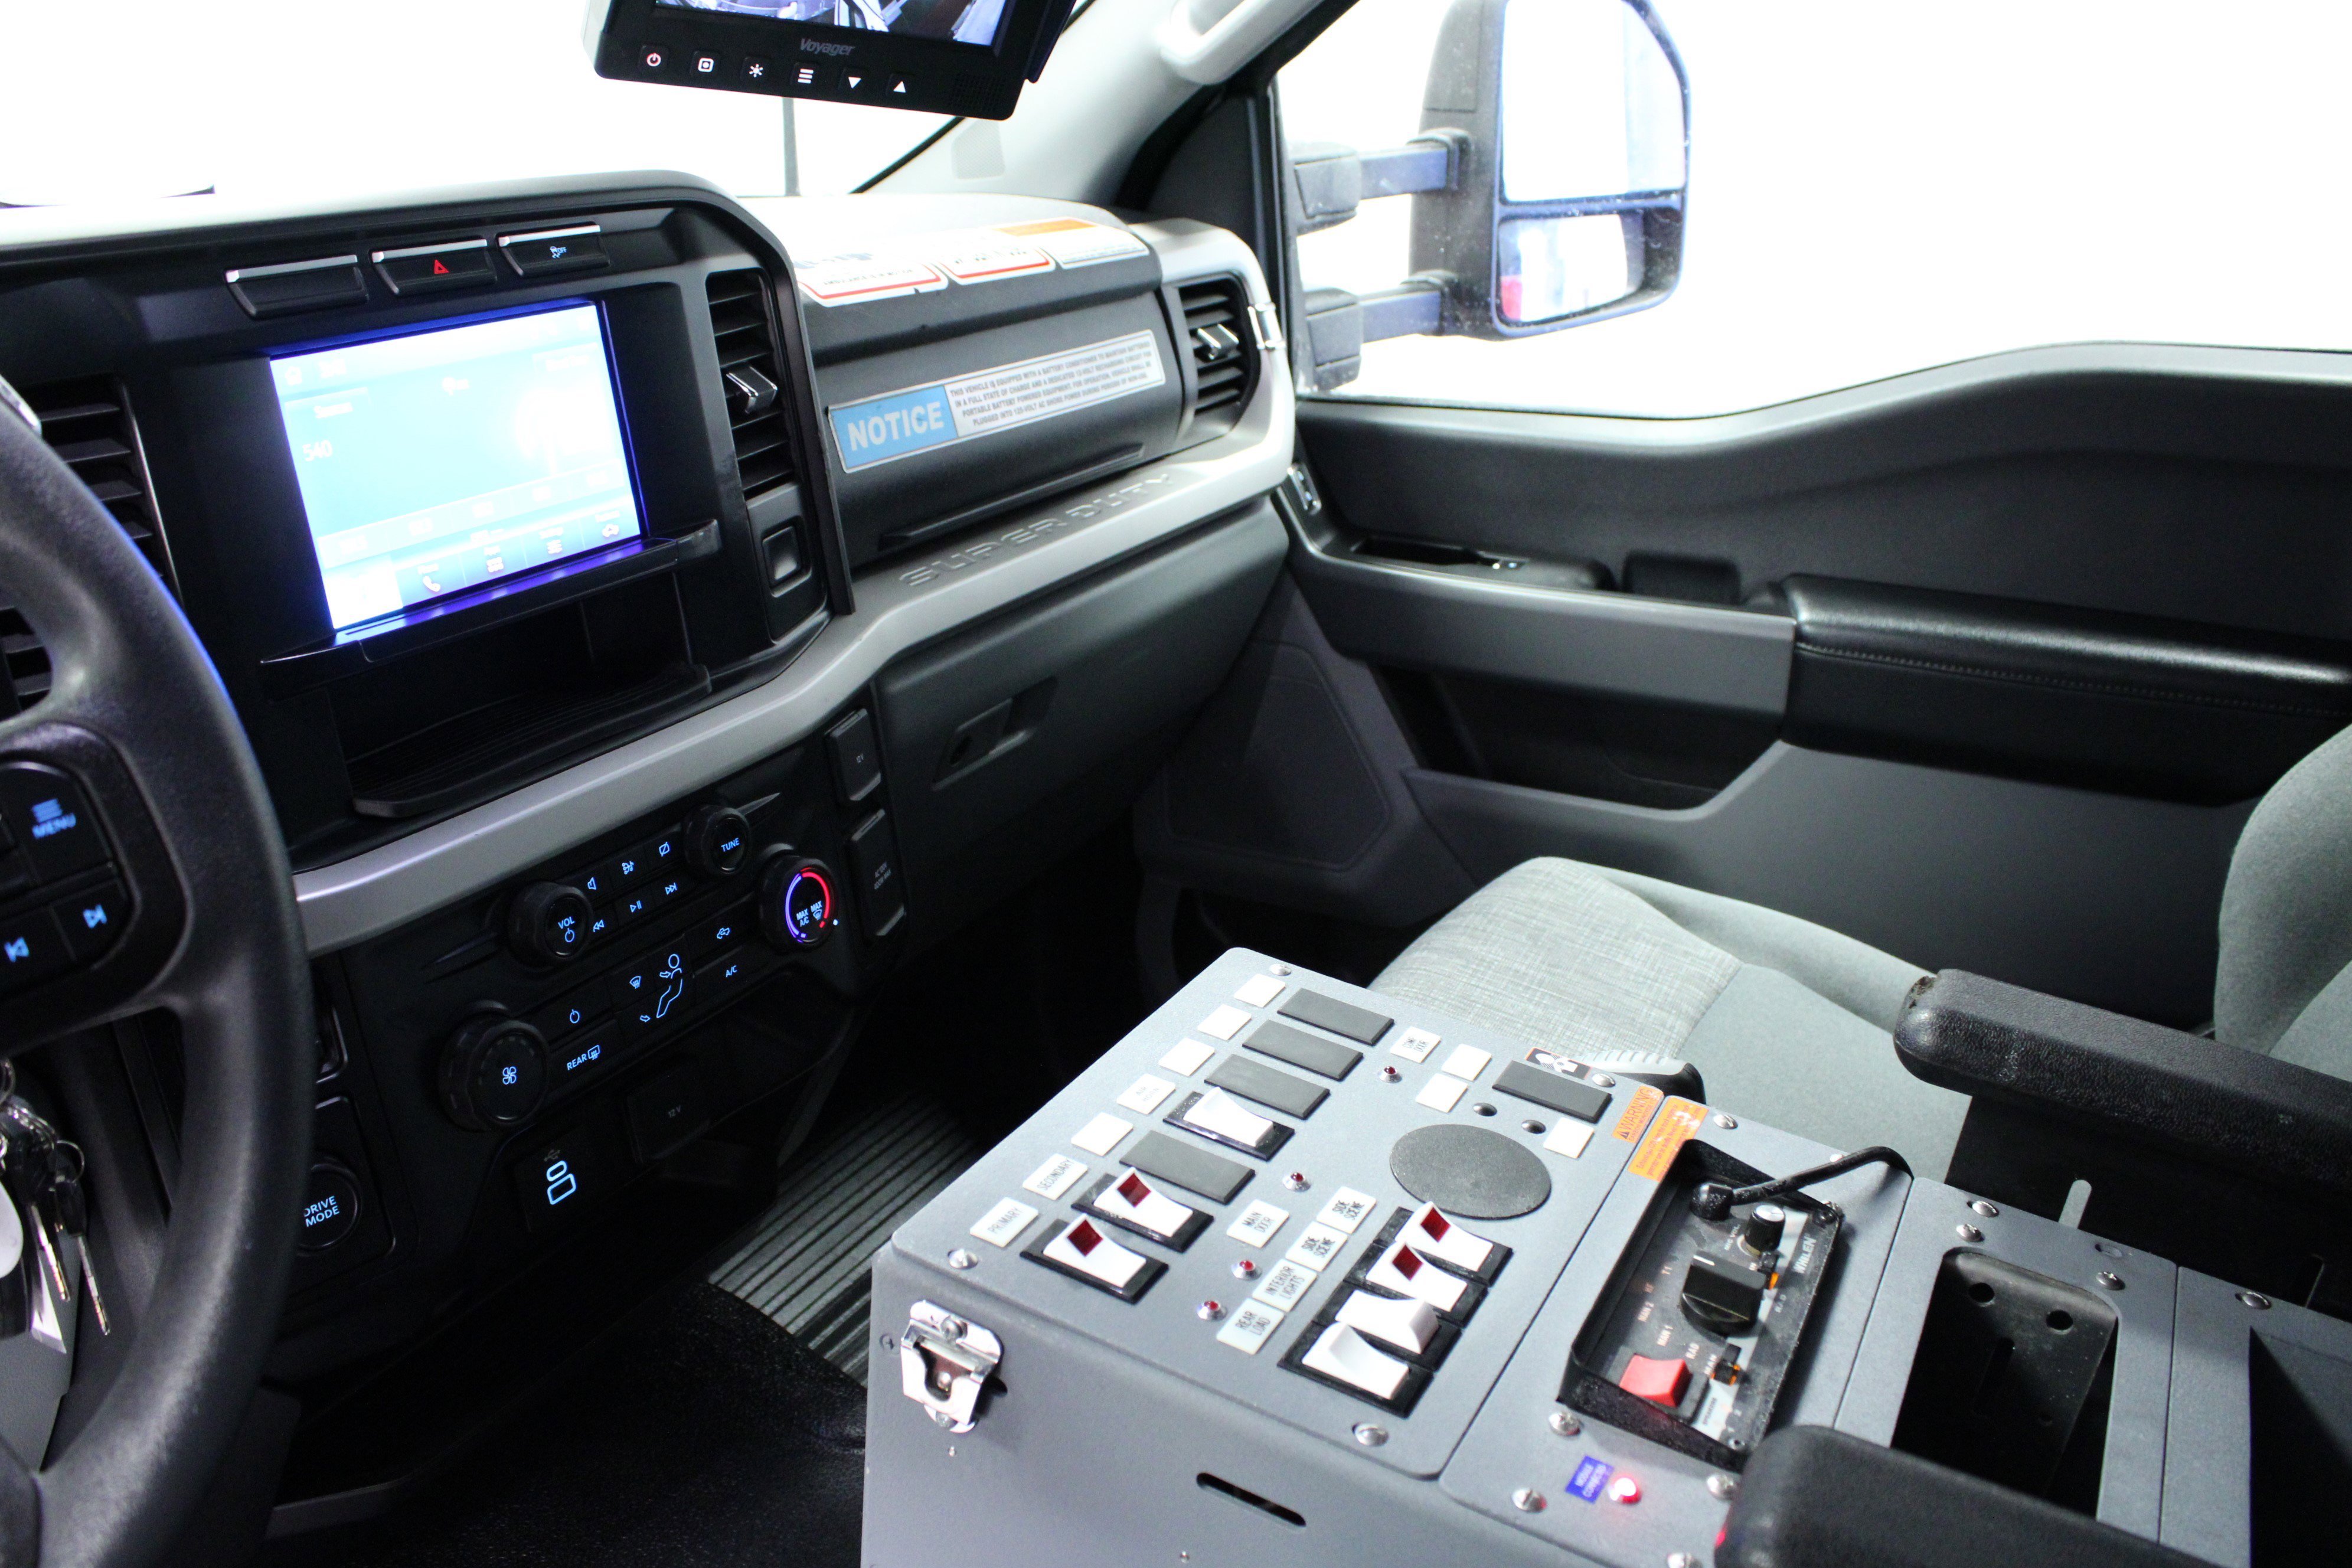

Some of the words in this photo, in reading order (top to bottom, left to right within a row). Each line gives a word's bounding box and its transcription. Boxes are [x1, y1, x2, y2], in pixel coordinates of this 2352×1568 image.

[800, 38, 856, 56] Voyager
[848, 401, 944, 452] NOTICE
[302, 439, 334, 462] 540
[899, 517, 1067, 586] SUPER
[1066, 473, 1173, 519] DUTY
[32, 812, 76, 839] MENU
[721, 838, 740, 852] TUNE
[796, 908, 809, 920] MAX
[810, 900, 822, 913] MAX
[558, 917, 575, 930] VOL
[725, 965, 737, 978] A/C
[567, 1053, 587, 1071] REAR
[1135, 1086, 1148, 1096] AIR
[1141, 1087, 1160, 1102] HORN
[668, 1109, 676, 1118] 12
[1622, 1087, 1652, 1132] WARNING
[1037, 1158, 1074, 1191] SECONDARY
[304, 1195, 337, 1217] DRIVE
[1332, 1200, 1350, 1214] SIDE
[1344, 1201, 1364, 1220] SCENE
[305, 1205, 340, 1227] MODE
[988, 1207, 1024, 1234] PRIMARY
[1242, 1211, 1262, 1227] MAIN
[1255, 1216, 1274, 1233] DOOR
[1301, 1236, 1319, 1252] SIDE
[1314, 1237, 1335, 1258] SCENE
[1794, 1235, 1817, 1274] WHELEN
[1265, 1266, 1295, 1296] INTERIOR
[1279, 1275, 1305, 1299] LIGHTS
[1235, 1311, 1257, 1329] REAR
[1638, 1307, 1652, 1322] MAN
[1250, 1317, 1270, 1335] LOAD
[1657, 1330, 1671, 1347] MAN
[1685, 1342, 1700, 1360] RAD
